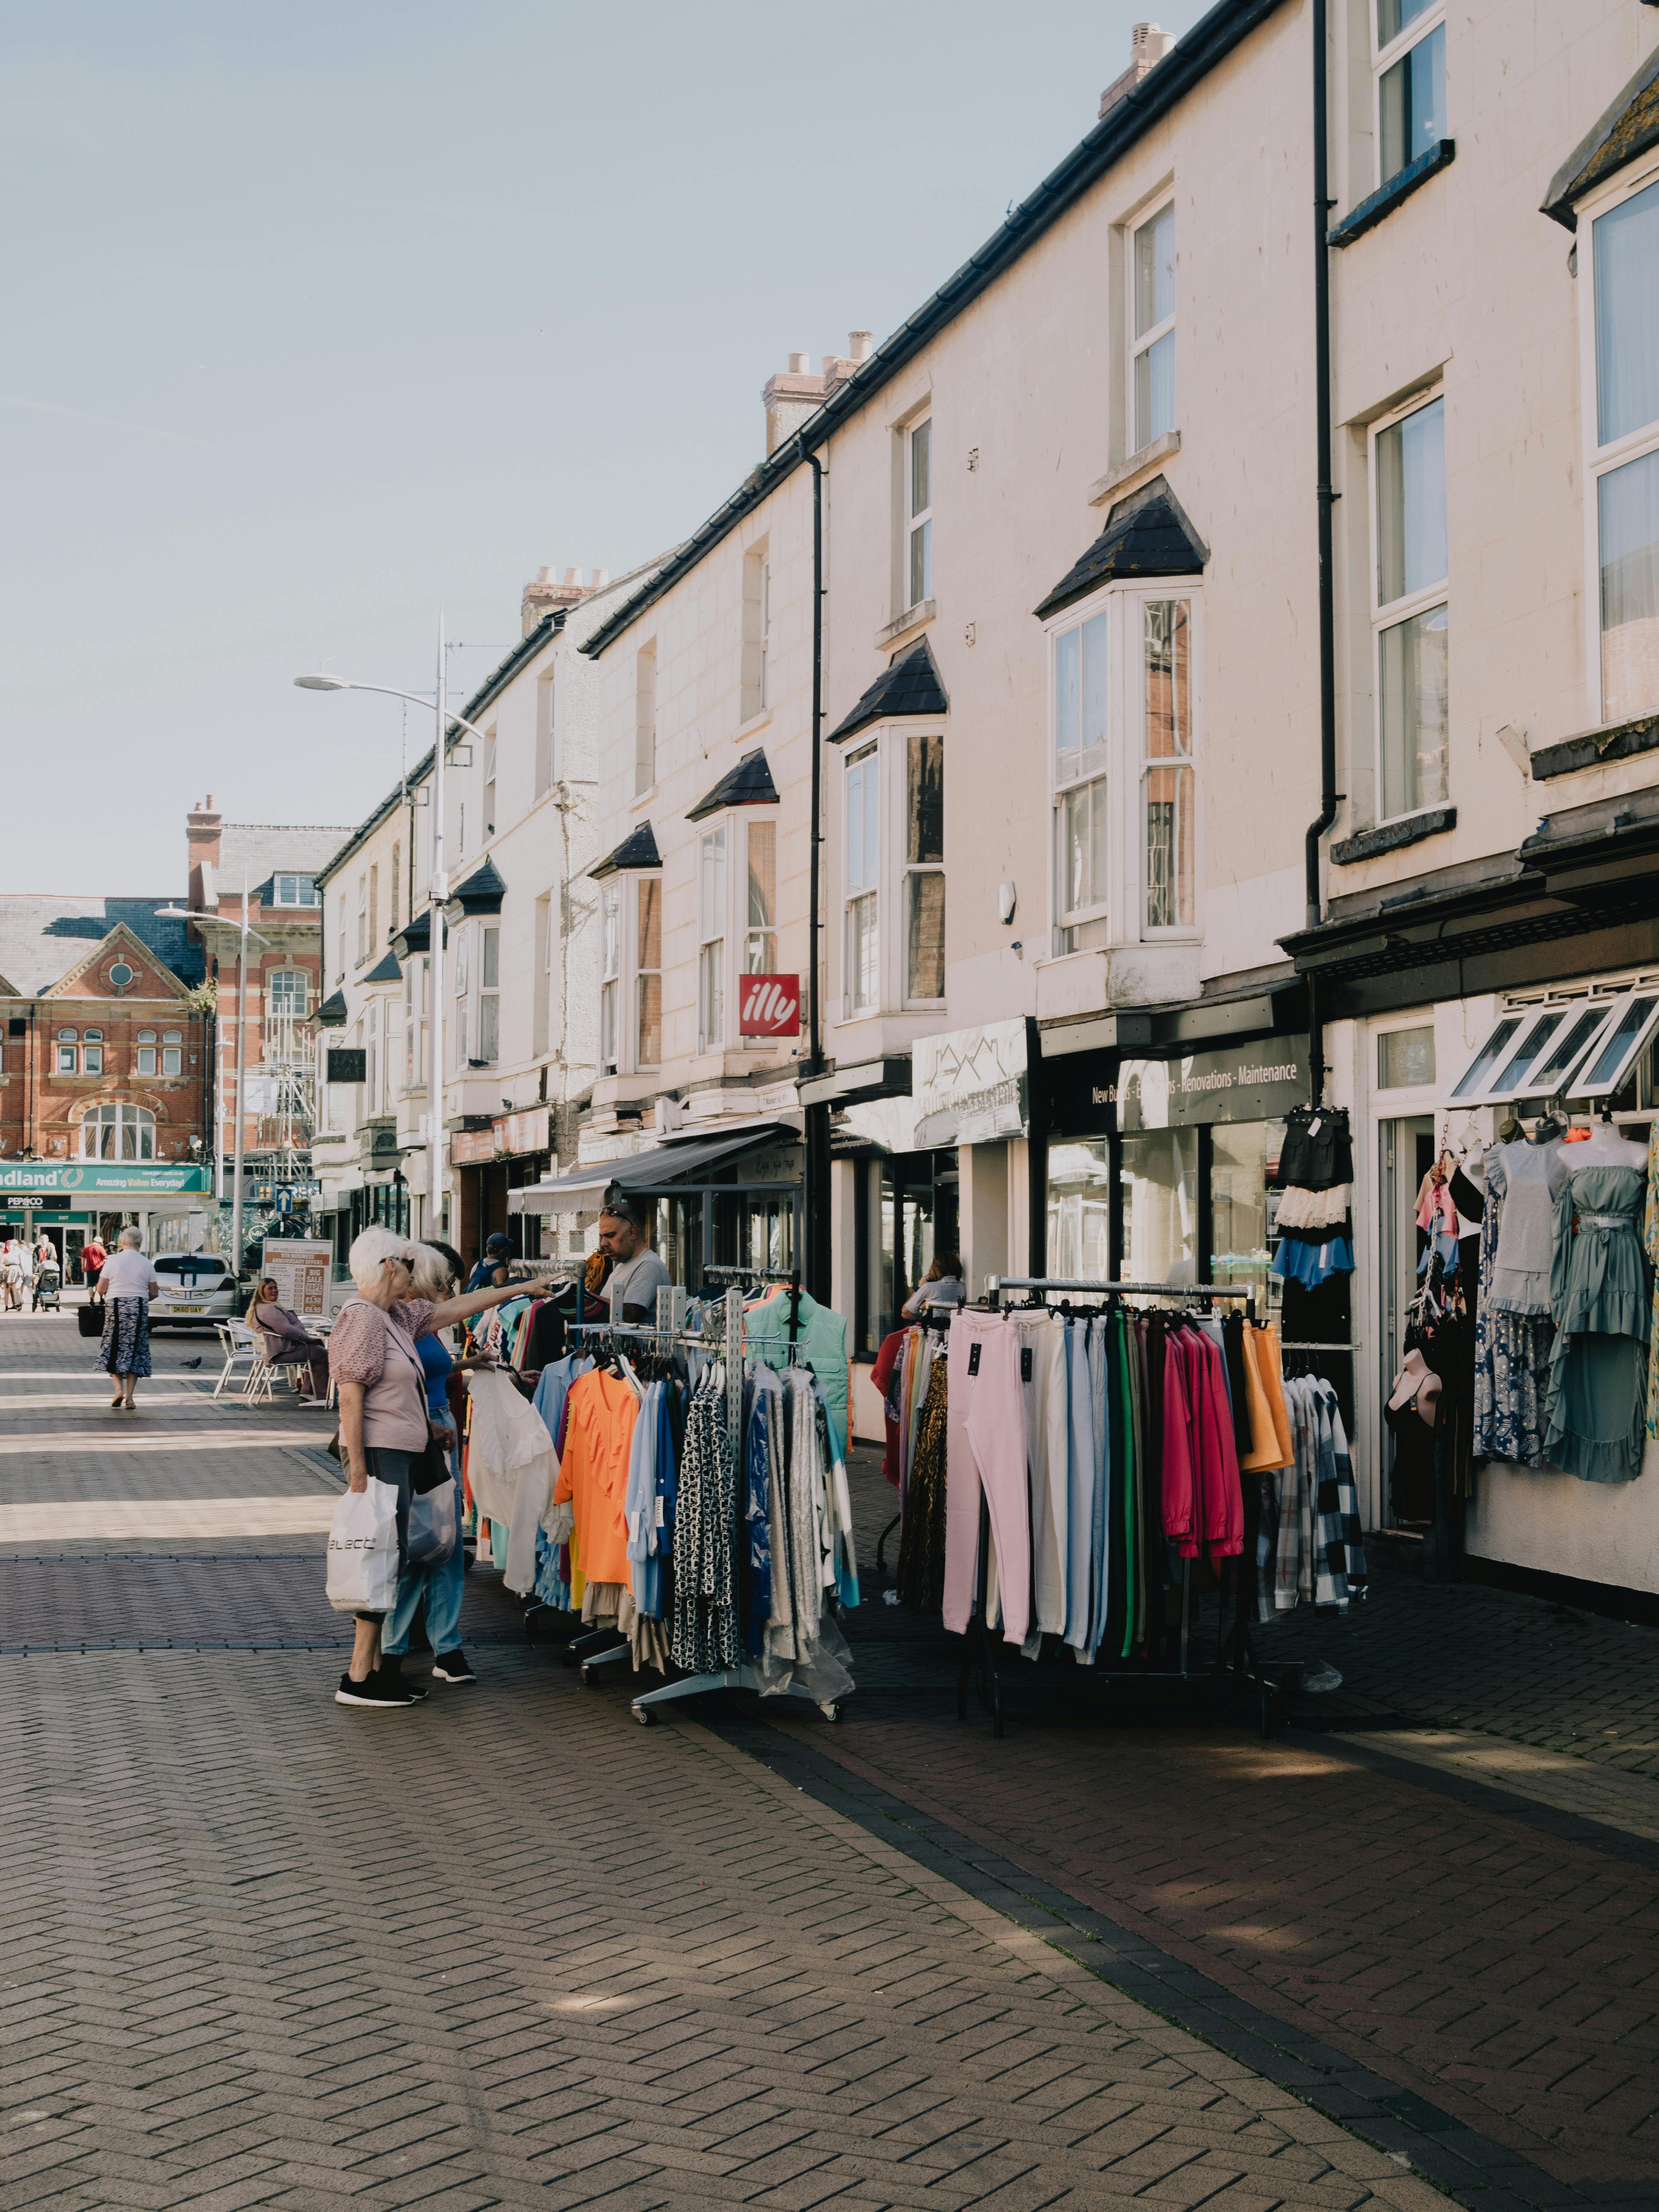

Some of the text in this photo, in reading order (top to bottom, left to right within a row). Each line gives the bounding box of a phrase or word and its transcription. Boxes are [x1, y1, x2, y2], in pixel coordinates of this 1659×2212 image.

[742, 983, 797, 1030] illy
[1182, 1070, 1232, 1092] Renovations
[1238, 1064, 1297, 1086] Maintenance
[1092, 1087, 1108, 1104] New
[1109, 1085, 1130, 1102] Buds
[96, 1179, 126, 1188] Amazing
[151, 1179, 184, 1188] Everyday!
